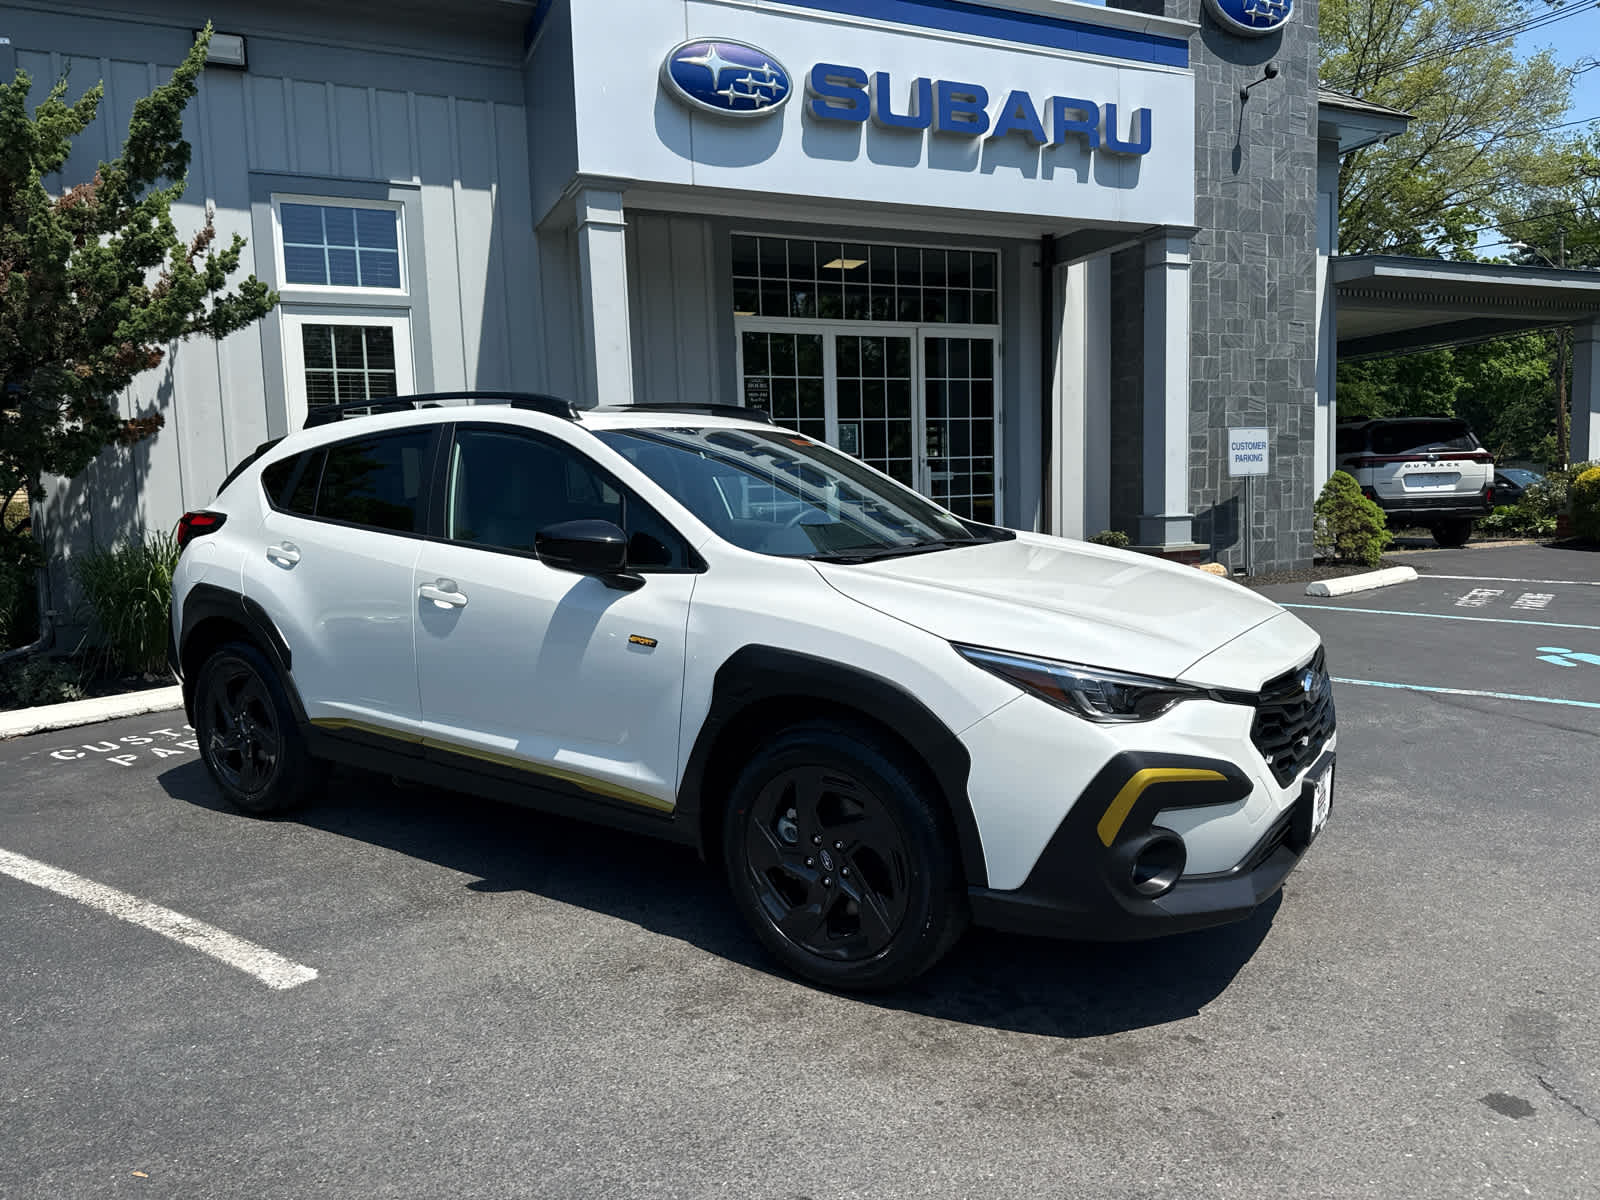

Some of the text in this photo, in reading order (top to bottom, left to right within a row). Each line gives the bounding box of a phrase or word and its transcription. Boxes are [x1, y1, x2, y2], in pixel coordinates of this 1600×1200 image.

[806, 62, 1152, 156] SUBARU
[1231, 441, 1267, 451] CUSTOMER
[1235, 453, 1264, 462] PARKING
